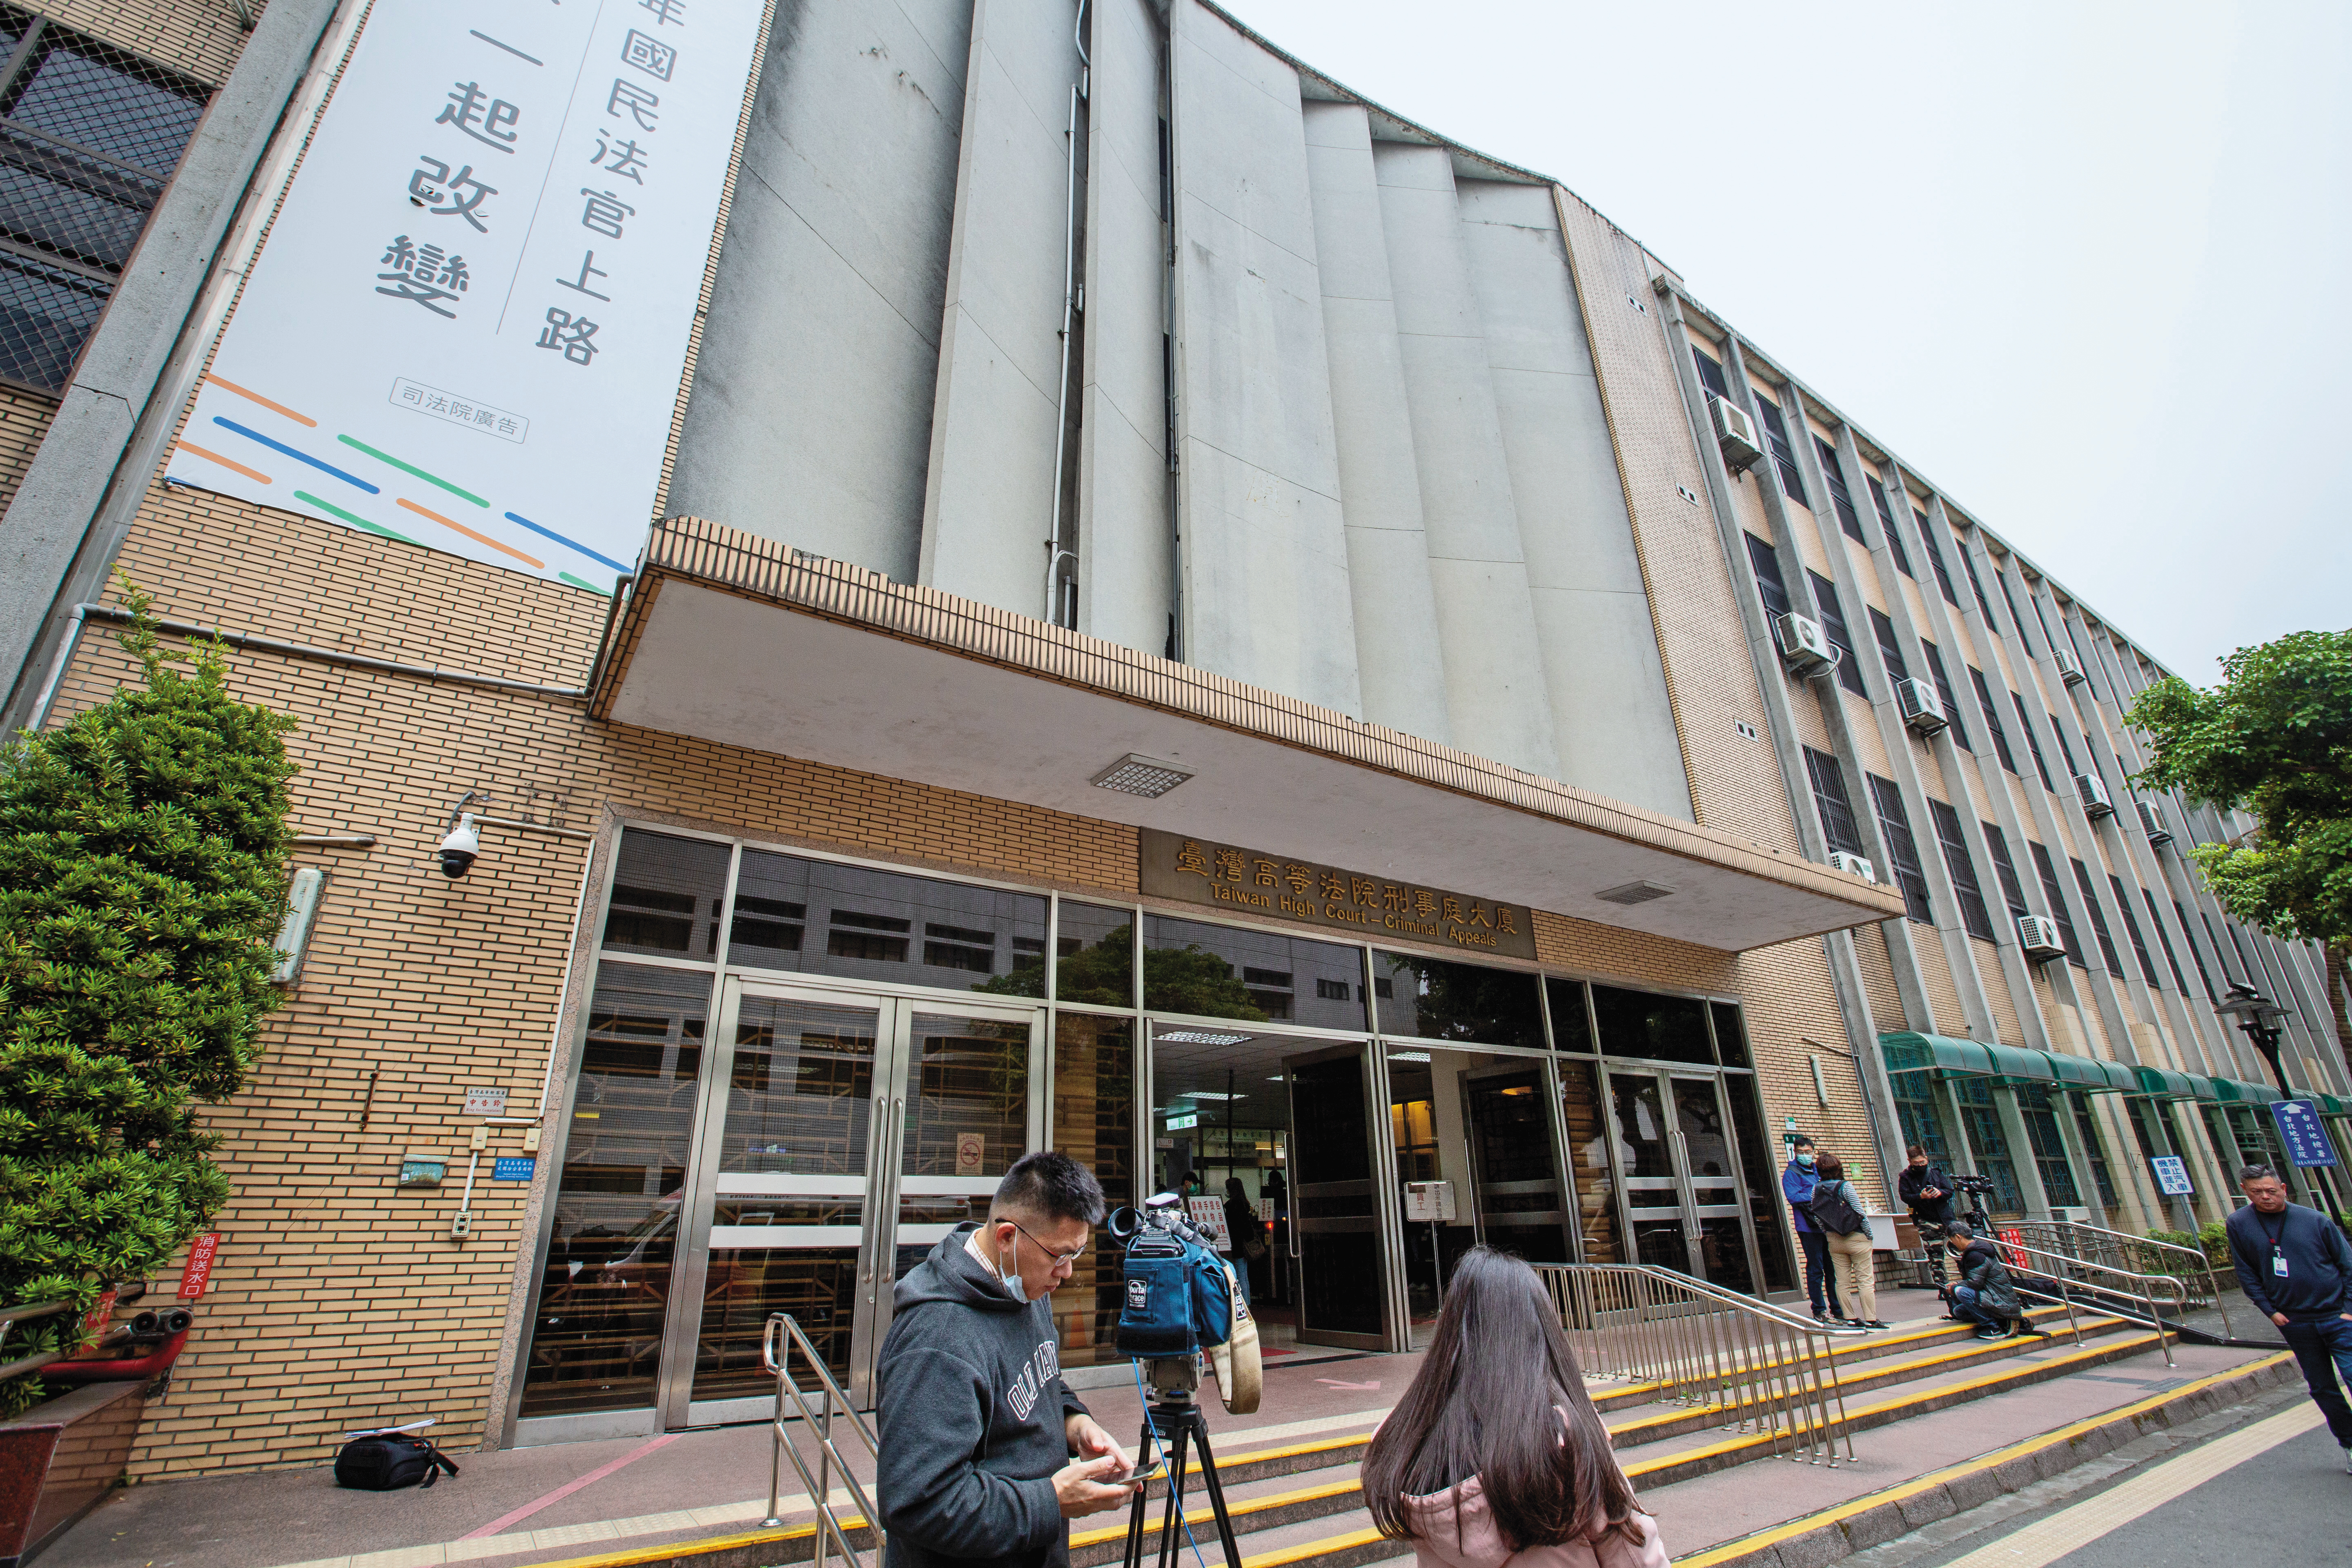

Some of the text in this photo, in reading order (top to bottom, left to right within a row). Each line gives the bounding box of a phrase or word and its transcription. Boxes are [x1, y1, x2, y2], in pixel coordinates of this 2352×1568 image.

[375, 0, 561, 319] 一起改變
[403, 386, 518, 435] 司法院廣告
[1176, 840, 1517, 934] 臺灣高等法院刑事庭大廈
[1211, 882, 1270, 907] Taiwan
[1280, 895, 1316, 917] High
[1325, 903, 1366, 924] Court
[1385, 914, 1439, 936] Criminal
[1449, 925, 1497, 947] Appeals
[470, 1099, 501, 1107] 申告鈴
[2283, 1115, 2308, 1158] 台北地方法院
[2302, 1114, 2325, 1157] 台北地檢署
[2157, 1159, 2178, 1192] 機車進入
[2167, 1159, 2188, 1190] 禁止汽車
[185, 1236, 216, 1295] 消防送水口
